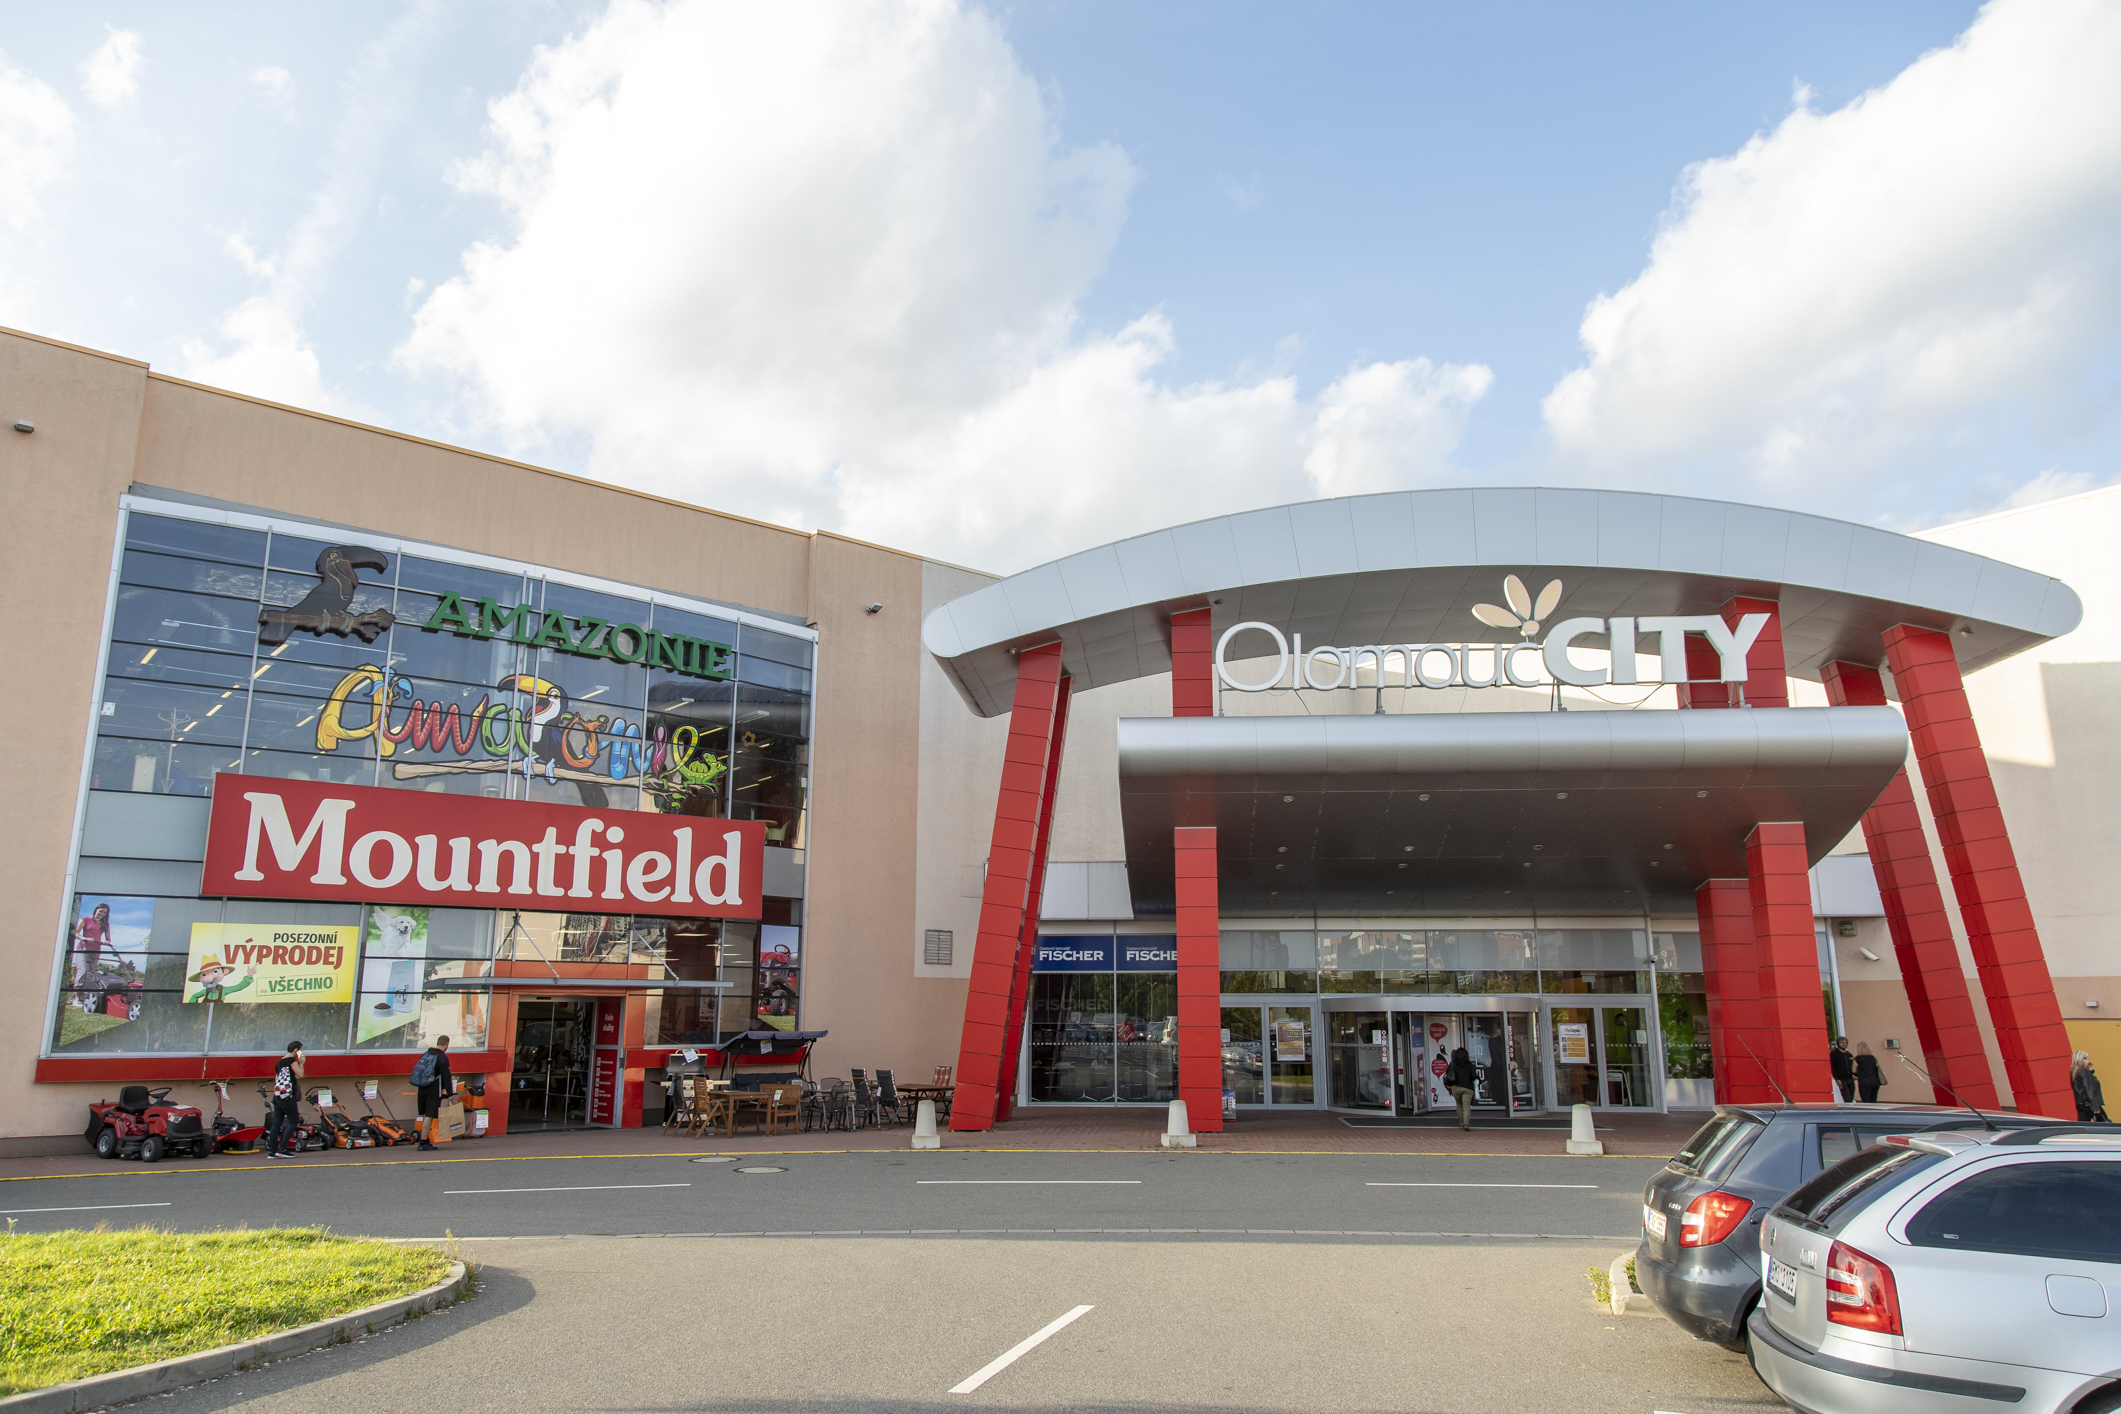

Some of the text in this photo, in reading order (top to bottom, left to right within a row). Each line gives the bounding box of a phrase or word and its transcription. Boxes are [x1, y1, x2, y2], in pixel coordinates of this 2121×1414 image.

[424, 590, 732, 680] AMAZONIE
[1215, 613, 1772, 692] Olomouc CITY
[234, 791, 743, 906] Mountfield
[273, 931, 338, 944] POSEZONNÍ
[224, 937, 344, 970] VÝPRODEJ
[1039, 950, 1104, 961] FISCHER
[1126, 950, 1178, 961] FISCHE
[268, 976, 334, 993] VŠECHNO
